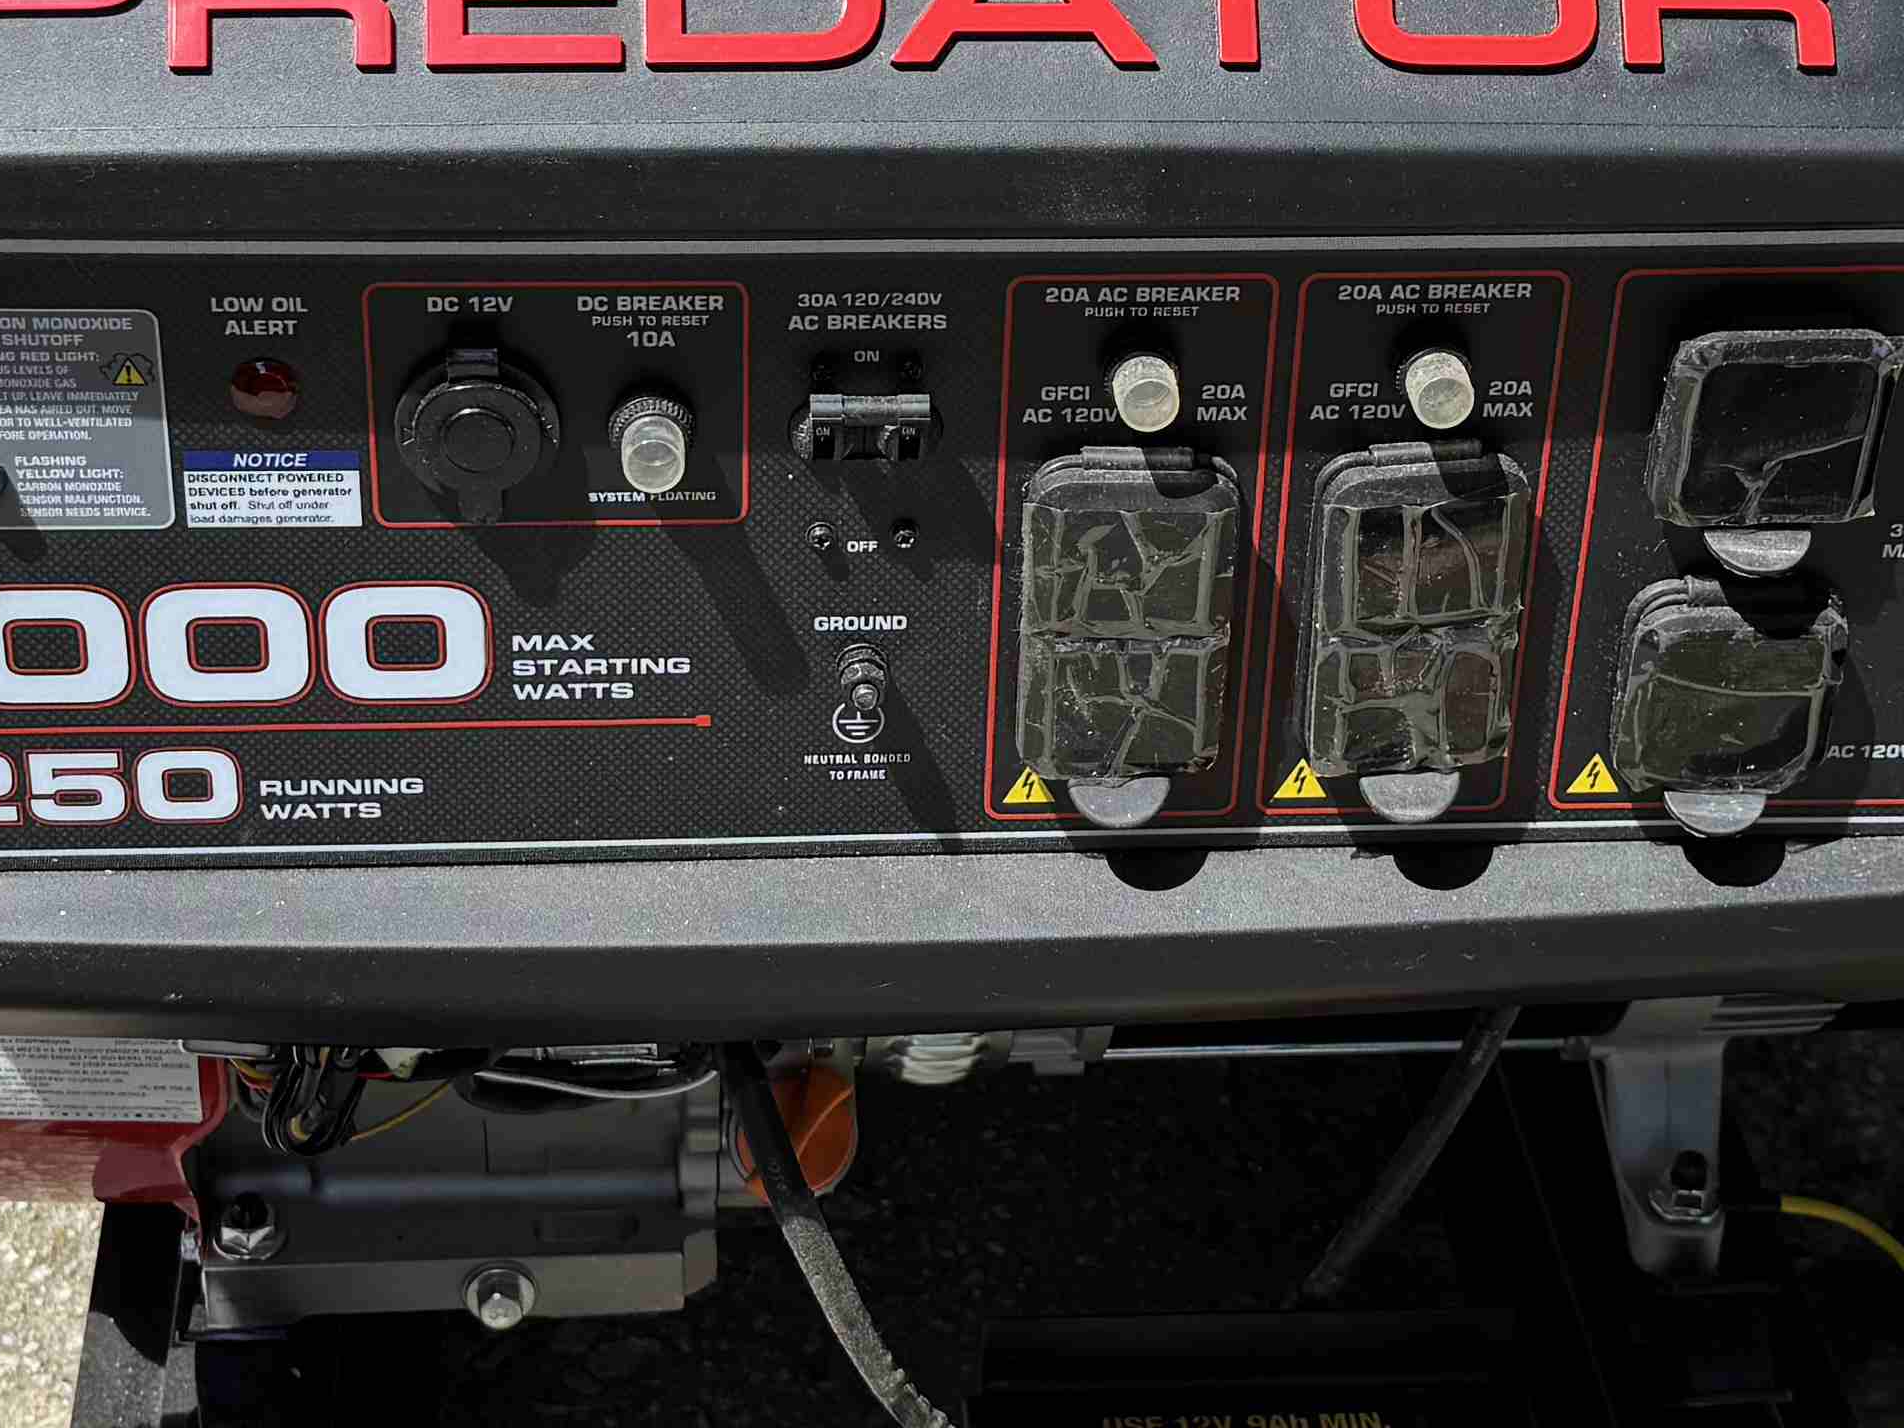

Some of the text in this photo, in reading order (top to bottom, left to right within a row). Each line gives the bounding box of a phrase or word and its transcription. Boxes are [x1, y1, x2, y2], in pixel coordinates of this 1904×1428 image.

[1045, 286, 1241, 303] 20A AC BREAKER
[1338, 282, 1533, 301] 20A AC BREAKER
[210, 296, 309, 313] LOW OIL
[426, 296, 514, 313] DC 12V
[576, 295, 726, 312] DC BREAKER
[797, 291, 943, 309] 30A 120/240V
[1084, 305, 1200, 318] PUSH TO RESET
[1375, 302, 1491, 315] PUSH TO RESET
[32, 316, 134, 331] MONOXIDE
[224, 320, 298, 336] ALERT
[591, 314, 710, 327] PUSH TO RESET
[787, 313, 948, 331] AC BREAKERS
[0, 333, 85, 347] SHUTOFF
[625, 331, 676, 348] 10A
[19, 350, 49, 362] RED
[54, 350, 100, 362] LIGHT:
[853, 349, 881, 363] ON
[12, 364, 53, 375] LEVELS
[55, 364, 71, 375] OF
[54, 377, 77, 389] GAS
[1328, 381, 1380, 398] GFCI
[1488, 380, 1533, 397] 20A
[30, 391, 64, 402] LEAVE
[66, 391, 139, 402] IMMEDIATELY
[1040, 385, 1091, 401] GFCI
[1201, 384, 1246, 400] 20A
[14, 404, 38, 415] HAS
[39, 404, 73, 415] AIRED
[101, 404, 133, 415] MOVE
[1022, 407, 1119, 423] AC 120V
[1196, 406, 1248, 422] MAX
[1309, 403, 1407, 421] AC 120V
[1482, 402, 1534, 419] MAX
[17, 417, 33, 428] TO
[35, 417, 133, 428] WELL-VENTILATED
[27, 430, 92, 441] OPERATION.
[814, 426, 831, 437] ON
[901, 427, 916, 436] ON
[14, 456, 87, 467] FLASHING
[233, 453, 309, 468] NOTICE
[15, 469, 125, 480] YELLOW LIGHT:
[187, 473, 345, 483] DISCONNECT POWERED
[16, 482, 122, 493] CARBON MONOXIDE
[188, 486, 353, 499] DEVICES before generator
[19, 494, 144, 505] SENSOR MALFUNCTION.
[587, 491, 717, 503] SYSTEM FLOATING
[20, 507, 151, 518] SENSOR NEEDS SERVICE.
[189, 500, 330, 510] shut off. Shut off under
[189, 514, 335, 526] load damages generator.
[847, 539, 879, 554] OFF
[813, 614, 908, 633] GROUND
[511, 633, 596, 652] MAX
[511, 657, 692, 676] STARTING
[511, 682, 635, 702] WATTS
[803, 752, 911, 765] NEUTRAL BONDED
[1826, 744, 1856, 760] AC
[828, 769, 886, 781] TO FRAME
[259, 777, 425, 796] RUNNING
[260, 801, 383, 821] WATTS
